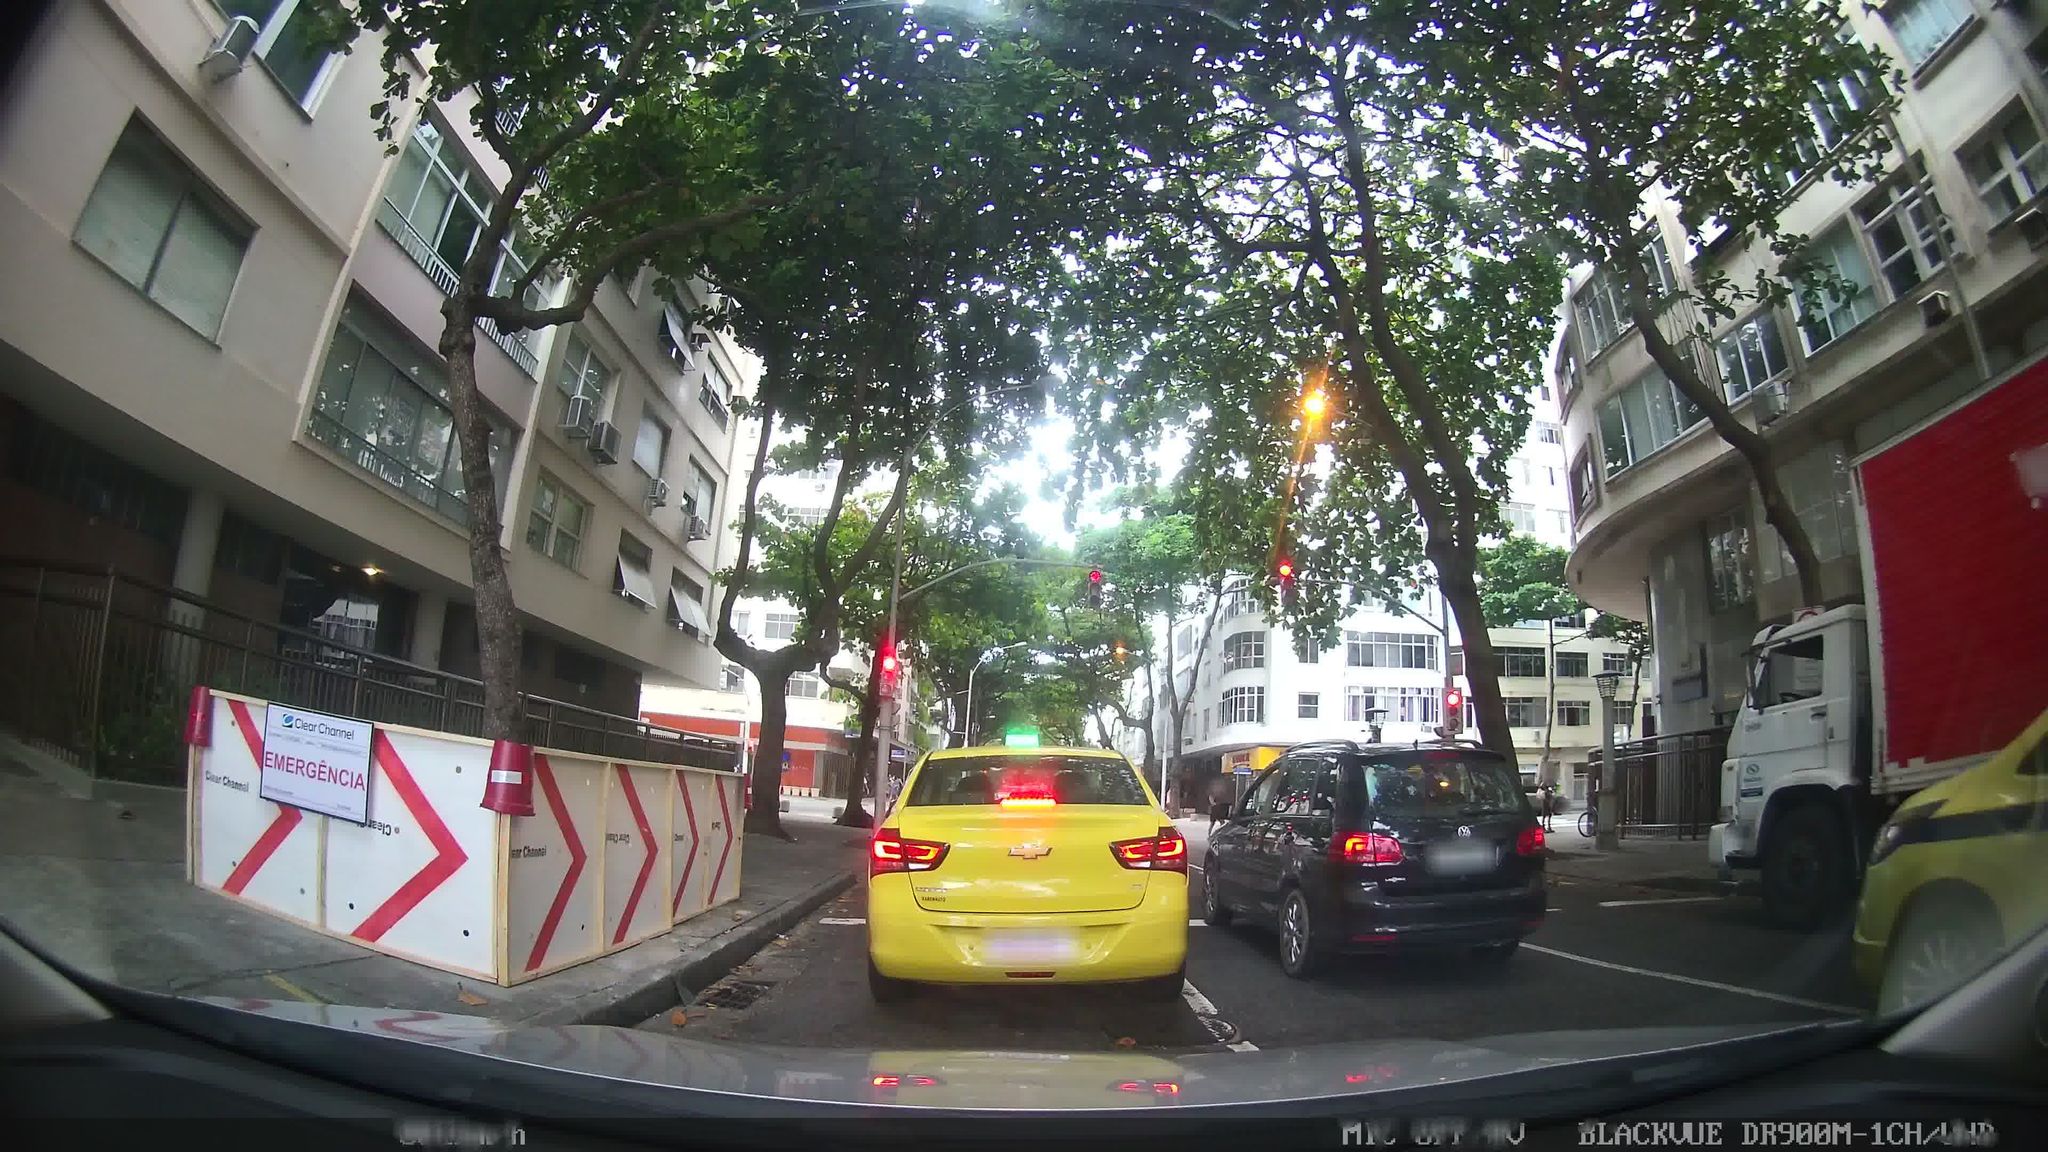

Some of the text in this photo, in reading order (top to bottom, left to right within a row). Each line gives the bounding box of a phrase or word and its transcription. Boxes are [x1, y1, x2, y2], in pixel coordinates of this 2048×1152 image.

[295, 718, 355, 740] Clear Channel
[264, 751, 366, 791] EMERGÊNCIA
